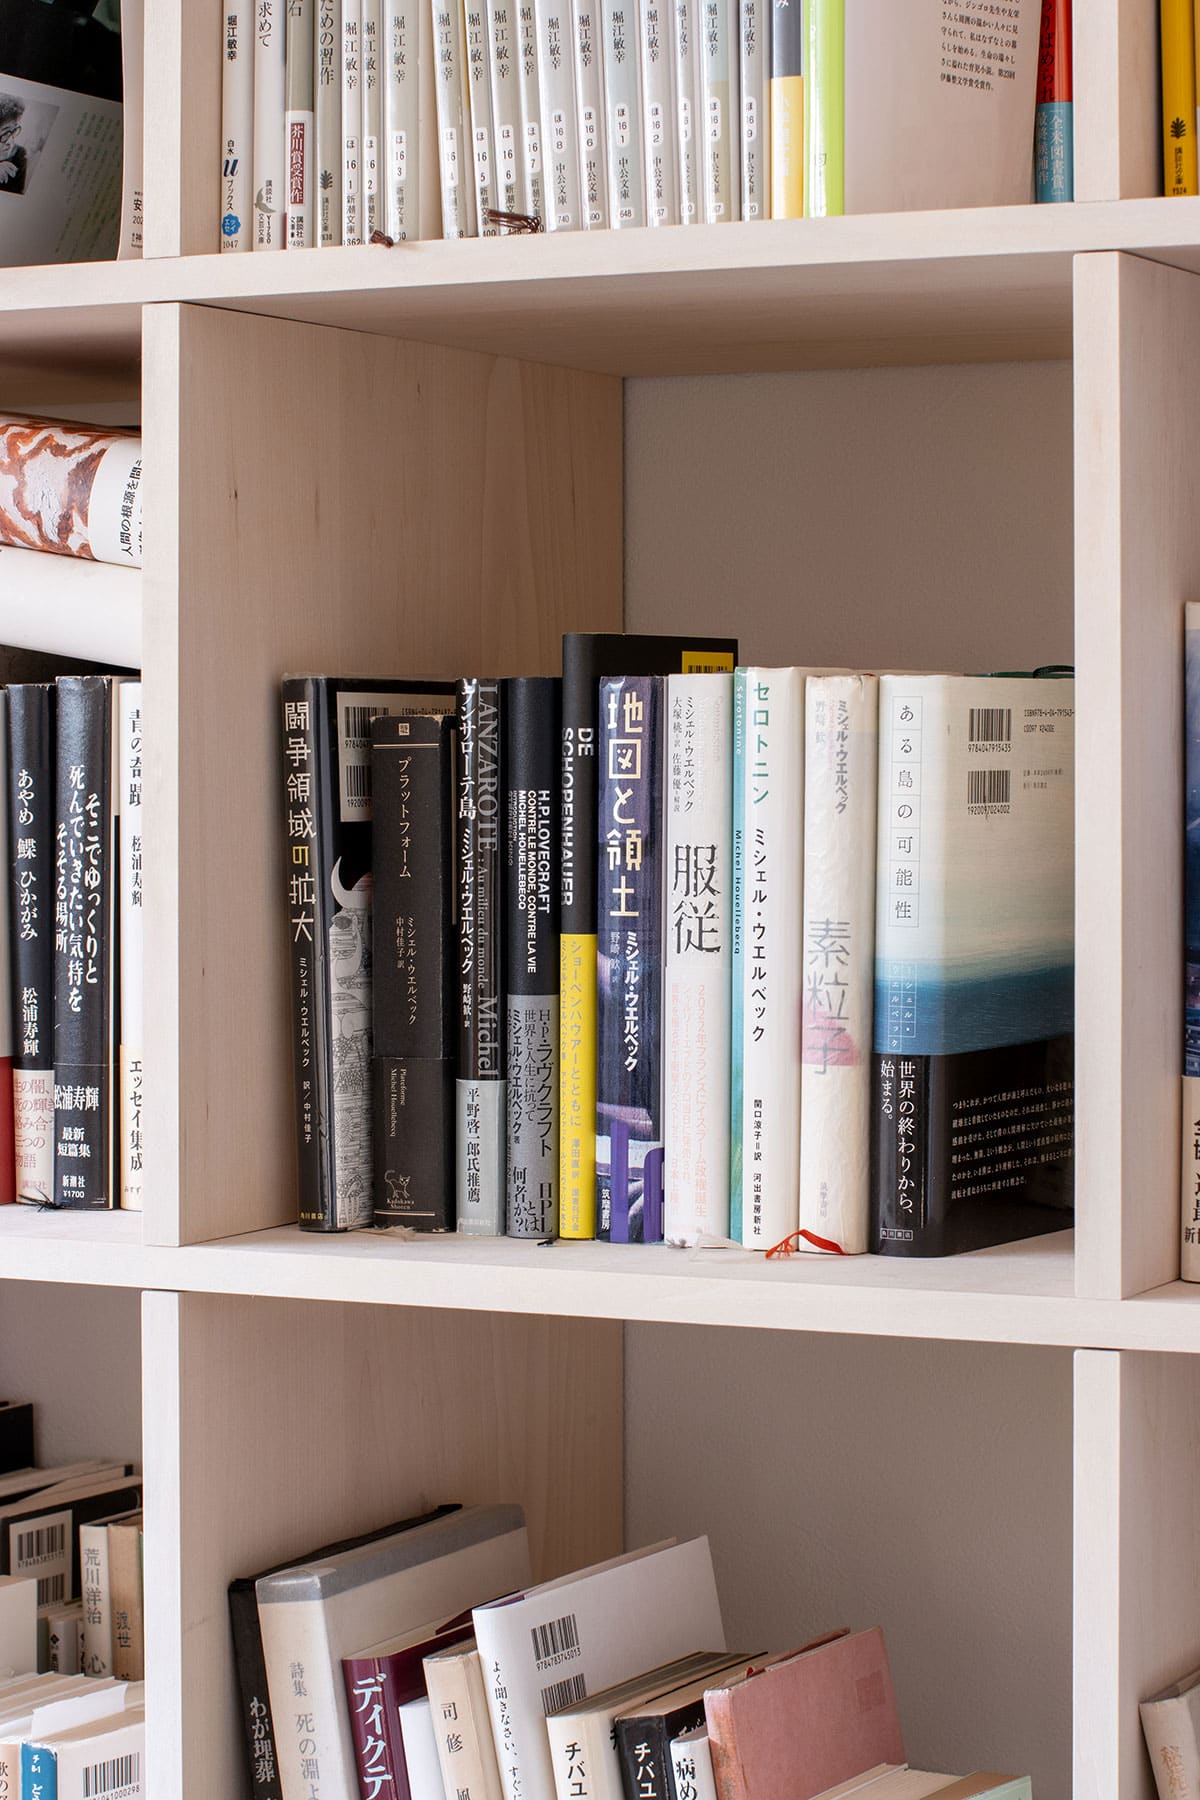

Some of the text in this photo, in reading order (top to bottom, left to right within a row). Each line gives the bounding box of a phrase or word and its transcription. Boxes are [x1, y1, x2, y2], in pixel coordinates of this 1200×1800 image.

[227, 15, 238, 62] 堀江敏幸
[258, 1, 273, 48] 求めて
[393, 16, 406, 84] 堀江敏幸
[468, 13, 483, 81] 堀江敏幸
[494, 9, 510, 79] 堀江敏幸
[548, 18, 561, 71] 堀江敏幸
[578, 15, 592, 67] 堀江敏幸
[612, 11, 626, 64] 堀江敏幸
[647, 9, 660, 63] 堀江敏幸
[345, 22, 358, 90] 堀江敏幸
[476, 131, 485, 141] ほ
[502, 129, 510, 138] ほ
[554, 114, 562, 123] ほ
[555, 128, 564, 136] 16
[584, 111, 593, 120] ほ
[585, 125, 595, 133] 16
[618, 108, 626, 117] ほ
[618, 122, 628, 130] 16
[620, 135, 625, 143] 1
[652, 120, 661, 129] 16
[652, 134, 660, 143] 2
[747, 129, 753, 138] 9
[290, 123, 304, 204] 芥川賞受賞作
[346, 160, 357, 169] 16
[477, 152, 487, 162] 16
[503, 150, 513, 159] 16
[530, 158, 536, 168] 7
[556, 141, 563, 150] 8
[586, 138, 594, 147] 6
[265, 179, 273, 204] 講談社
[348, 180, 352, 190] 1
[368, 180, 373, 189] 2
[397, 166, 402, 176] 3
[480, 174, 486, 182] 5
[506, 171, 512, 180] 6
[555, 162, 567, 205] 中公文庫
[585, 160, 598, 202] 中公文庫
[618, 157, 630, 200] 中公文庫
[222, 239, 239, 249] 1047
[477, 684, 498, 852] LANZAROTE
[577, 727, 594, 758] DE
[683, 696, 696, 813] ミシェル・ウエルベック
[835, 699, 849, 815] ミシェル・ウエルベック
[17, 769, 35, 826] あやめ
[284, 701, 318, 943] 闘争領域の拡大
[398, 755, 413, 879] プラットフォーム
[561, 727, 574, 907] SCHOPENHAUER
[606, 690, 643, 918] 地図と領土
[894, 703, 915, 921] ある島の可能性
[518, 790, 527, 911] MICHEL HOUELLEBECQ
[538, 790, 551, 914] H.P.LOVECRAFT
[20, 870, 38, 942] ひかがみ
[54, 822, 68, 955] そそる場所
[68, 764, 86, 1012] 死んでいきたい気持を
[83, 791, 103, 985] そこでゆっくりと
[460, 828, 477, 975] ミシェル・ウエルベック
[478, 886, 488, 925] milieu
[527, 790, 537, 973] CONTRE LE MONDE, CONTRE LA VIE
[672, 843, 722, 954] 服従
[734, 829, 743, 956] Michel Houellebecq
[478, 926, 488, 943] du
[749, 681, 770, 1236] セロトニン ミシェル・ウエルベック 河出書房新社
[406, 916, 418, 1025] ミシェル・ウエルベック
[478, 945, 488, 989] monde
[21, 986, 40, 1057] 松浦寿輝
[298, 956, 311, 1068] ミシェル・ウエルベック
[623, 931, 640, 1072] ミシェル・ウエルベック
[807, 917, 852, 1076] 素粒子
[478, 995, 499, 1076] Michel
[569, 940, 583, 1127] ショーペンハウアーとともに
[524, 1009, 537, 1122] 世界と人生に抗って
[879, 1059, 895, 1120] 始まる。
[62, 1126, 85, 1142] 最新
[129, 1060, 143, 1171] エッセイ集成
[897, 1060, 917, 1214] 世界の終わりから、
[57, 1142, 92, 1158] 短篇集
[466, 1087, 481, 1204] 平野啓一郎氏推薦
[62, 1174, 86, 1188] 新潮社
[525, 1200, 540, 1232] とは
[84, 1548, 106, 1674] 荒川洋治 心
[288, 1661, 308, 1697] 詩集
[535, 1647, 583, 1672] 9784783745013
[249, 1695, 276, 1784] わが埋葬
[564, 1741, 588, 1797] チバユ
[633, 1741, 658, 1798] チバユ
[675, 1757, 698, 1800] 病め
